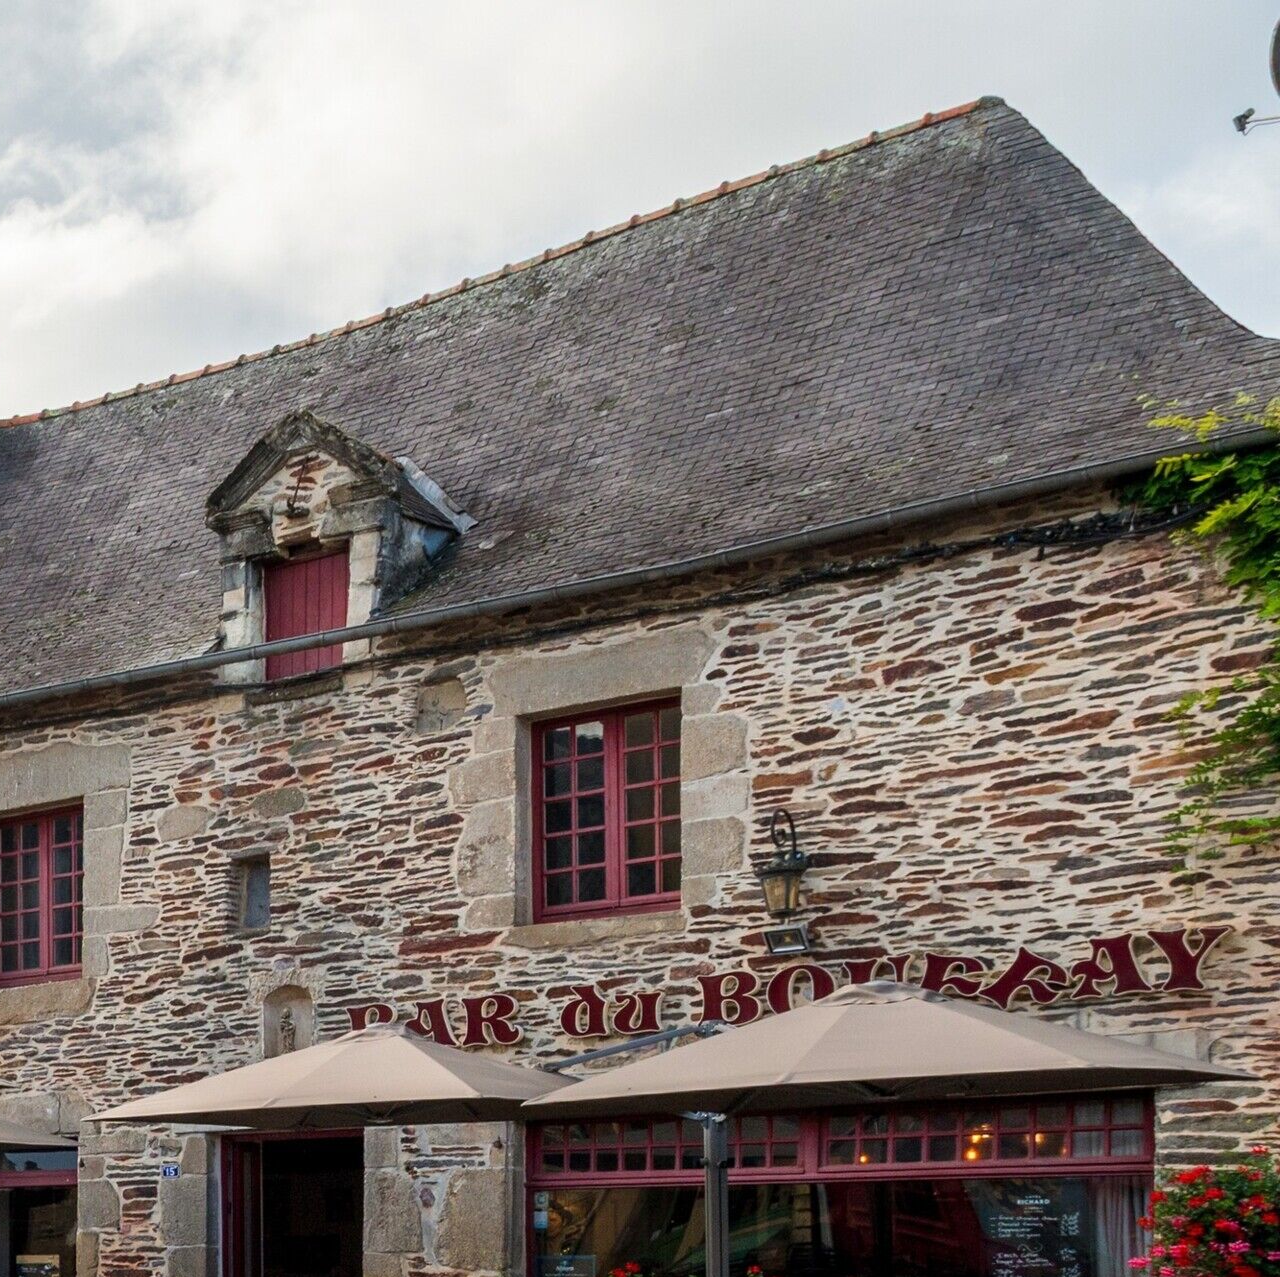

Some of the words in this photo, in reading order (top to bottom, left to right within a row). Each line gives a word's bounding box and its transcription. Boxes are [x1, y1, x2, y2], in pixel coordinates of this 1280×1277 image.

[345, 993, 524, 1047] BAR
[559, 984, 662, 1038] du
[166, 1167, 175, 1176] 15
